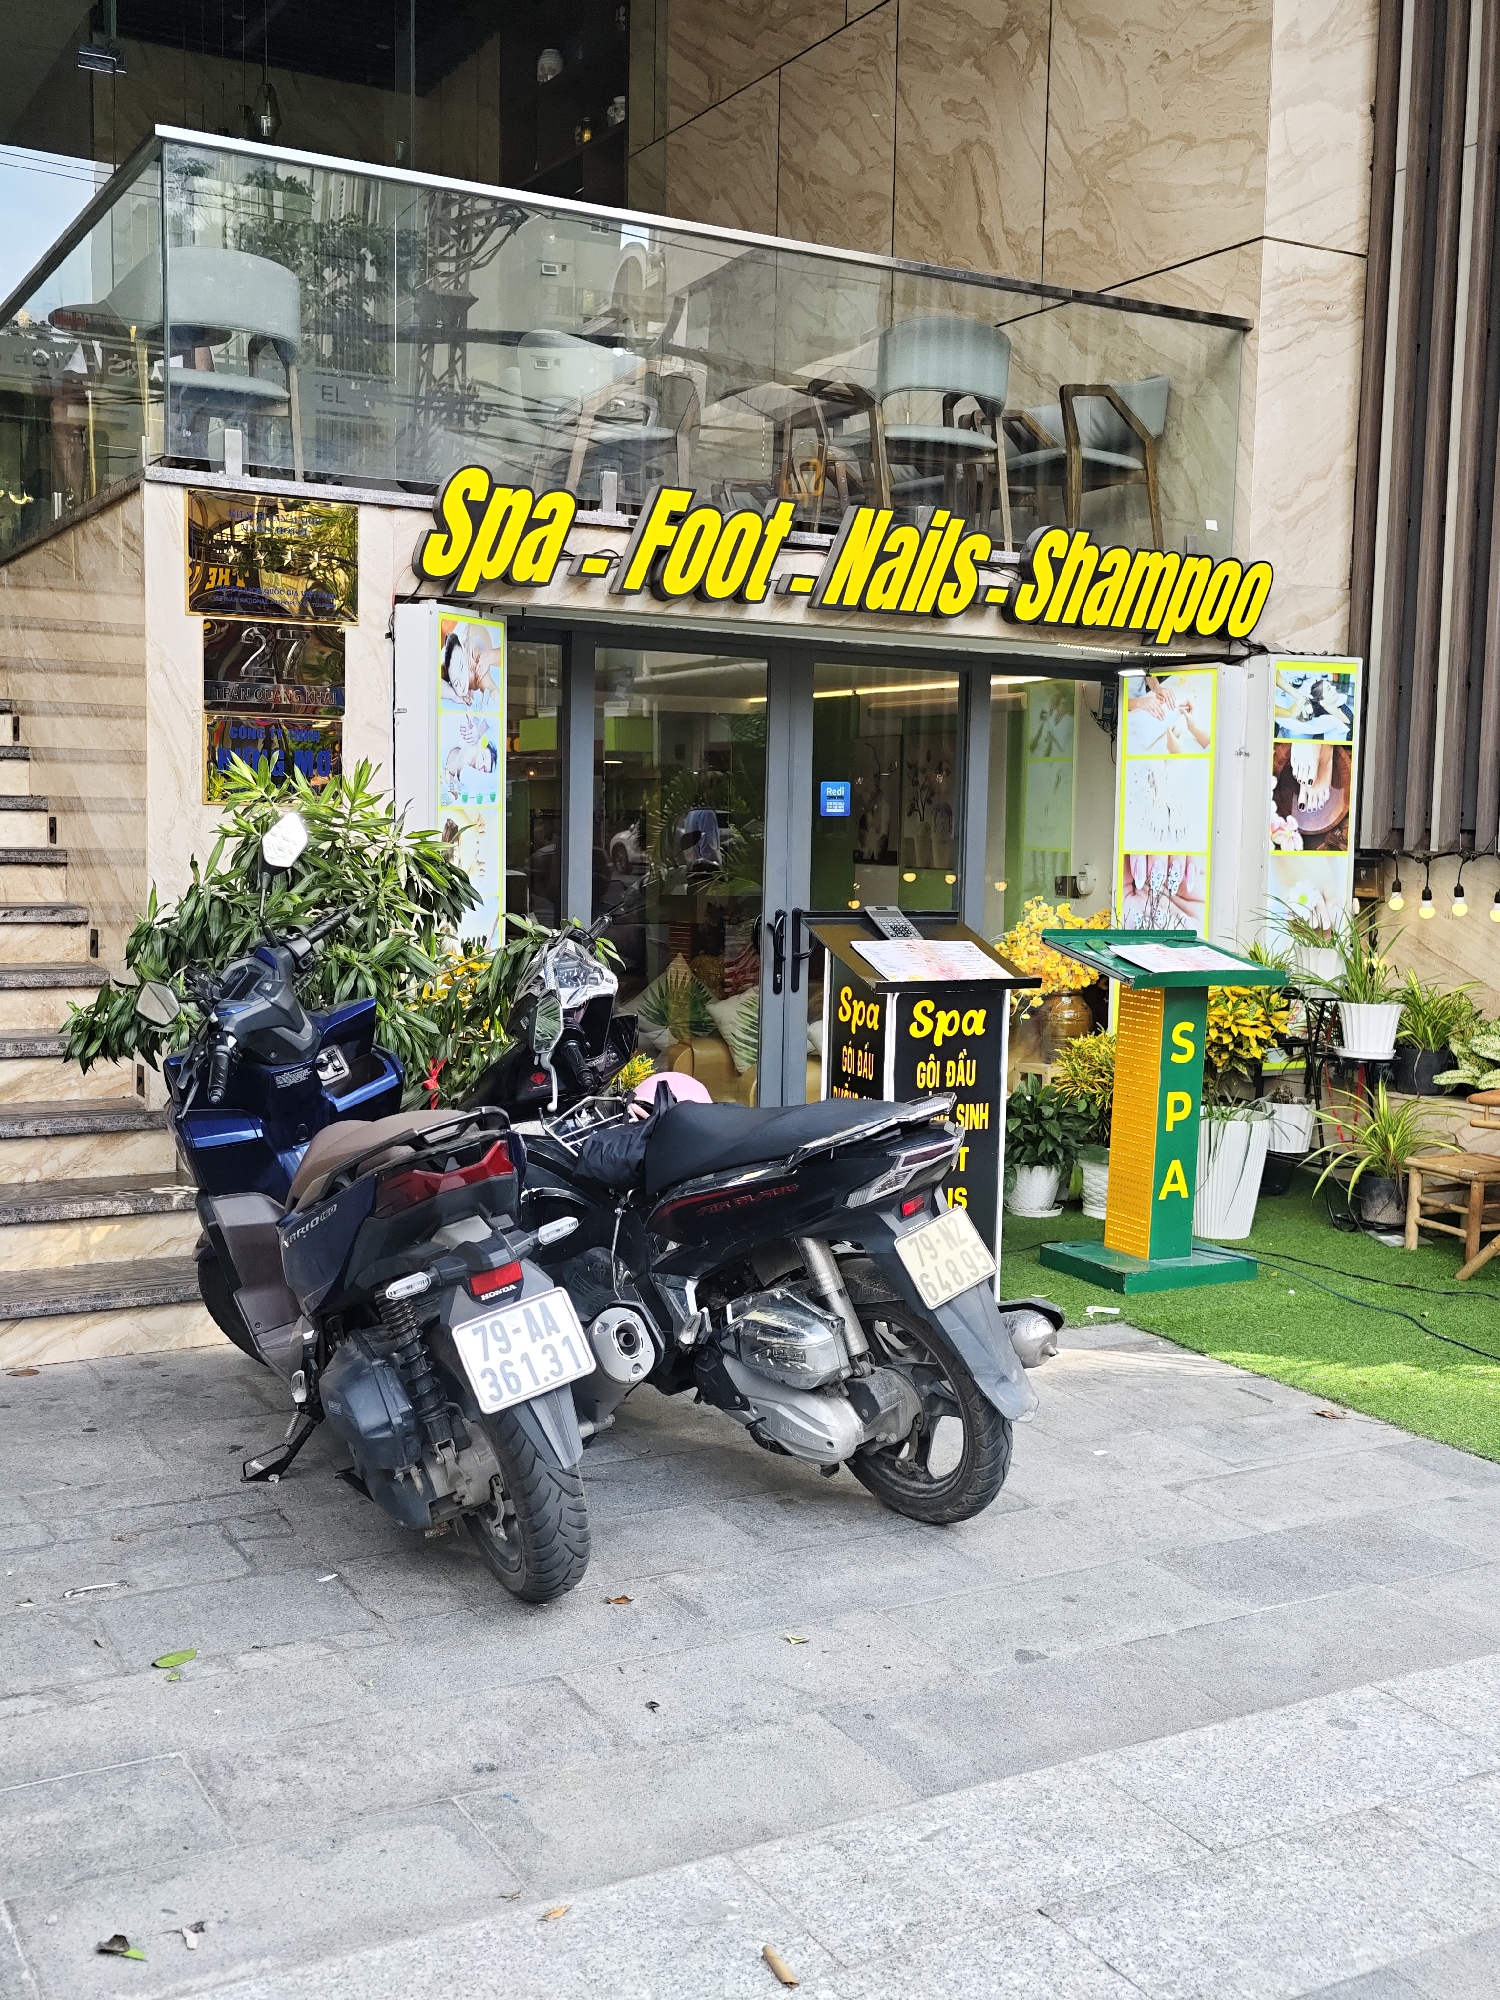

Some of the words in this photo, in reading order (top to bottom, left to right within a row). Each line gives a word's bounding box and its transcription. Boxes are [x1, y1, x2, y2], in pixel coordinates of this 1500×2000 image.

[422, 467, 577, 593] Spa
[623, 488, 797, 602] Foot
[825, 507, 991, 615] Nails
[1014, 529, 1273, 644] Shampoo
[240, 626, 312, 680] 27
[254, 685, 301, 704] QUANG
[229, 724, 266, 740] CÔNG
[270, 729, 283, 741] TY
[838, 985, 880, 1034] Spa
[909, 1000, 987, 1047] Spa
[956, 1103, 990, 1131] SINH
[1158, 1021, 1195, 1201] SPA
[480, 1284, 517, 1301] HONDA
[918, 1242, 992, 1302] 648.95
[471, 1301, 561, 1363] 79-AA
[480, 1335, 582, 1402] 361.31
